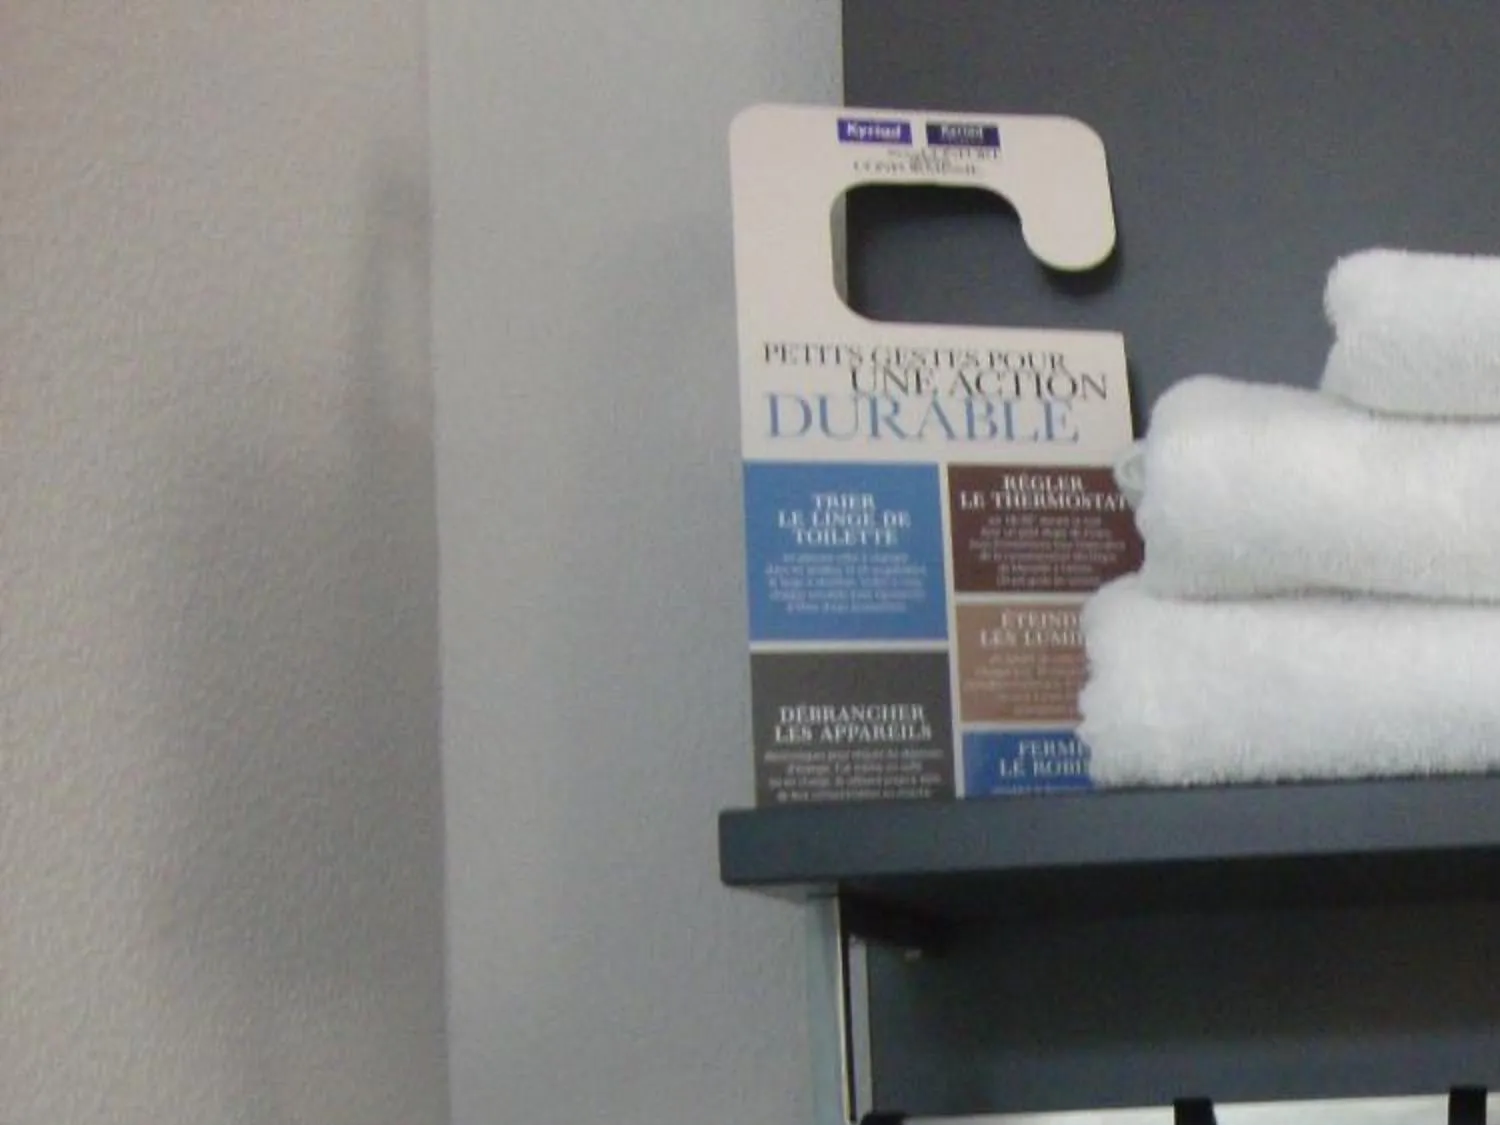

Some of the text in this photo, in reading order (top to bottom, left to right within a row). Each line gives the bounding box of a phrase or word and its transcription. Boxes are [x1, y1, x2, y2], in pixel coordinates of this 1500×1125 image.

[763, 342, 1066, 371] PETITS GESTES POUR
[850, 367, 1109, 401] UNE ACTION
[766, 391, 1081, 443] DURABLE
[812, 492, 876, 510] TRIER
[960, 490, 986, 511] LE
[777, 510, 912, 529] LE LINGE DE
[794, 527, 899, 546] TOILETTE
[774, 721, 934, 745] LES APPAREILS
